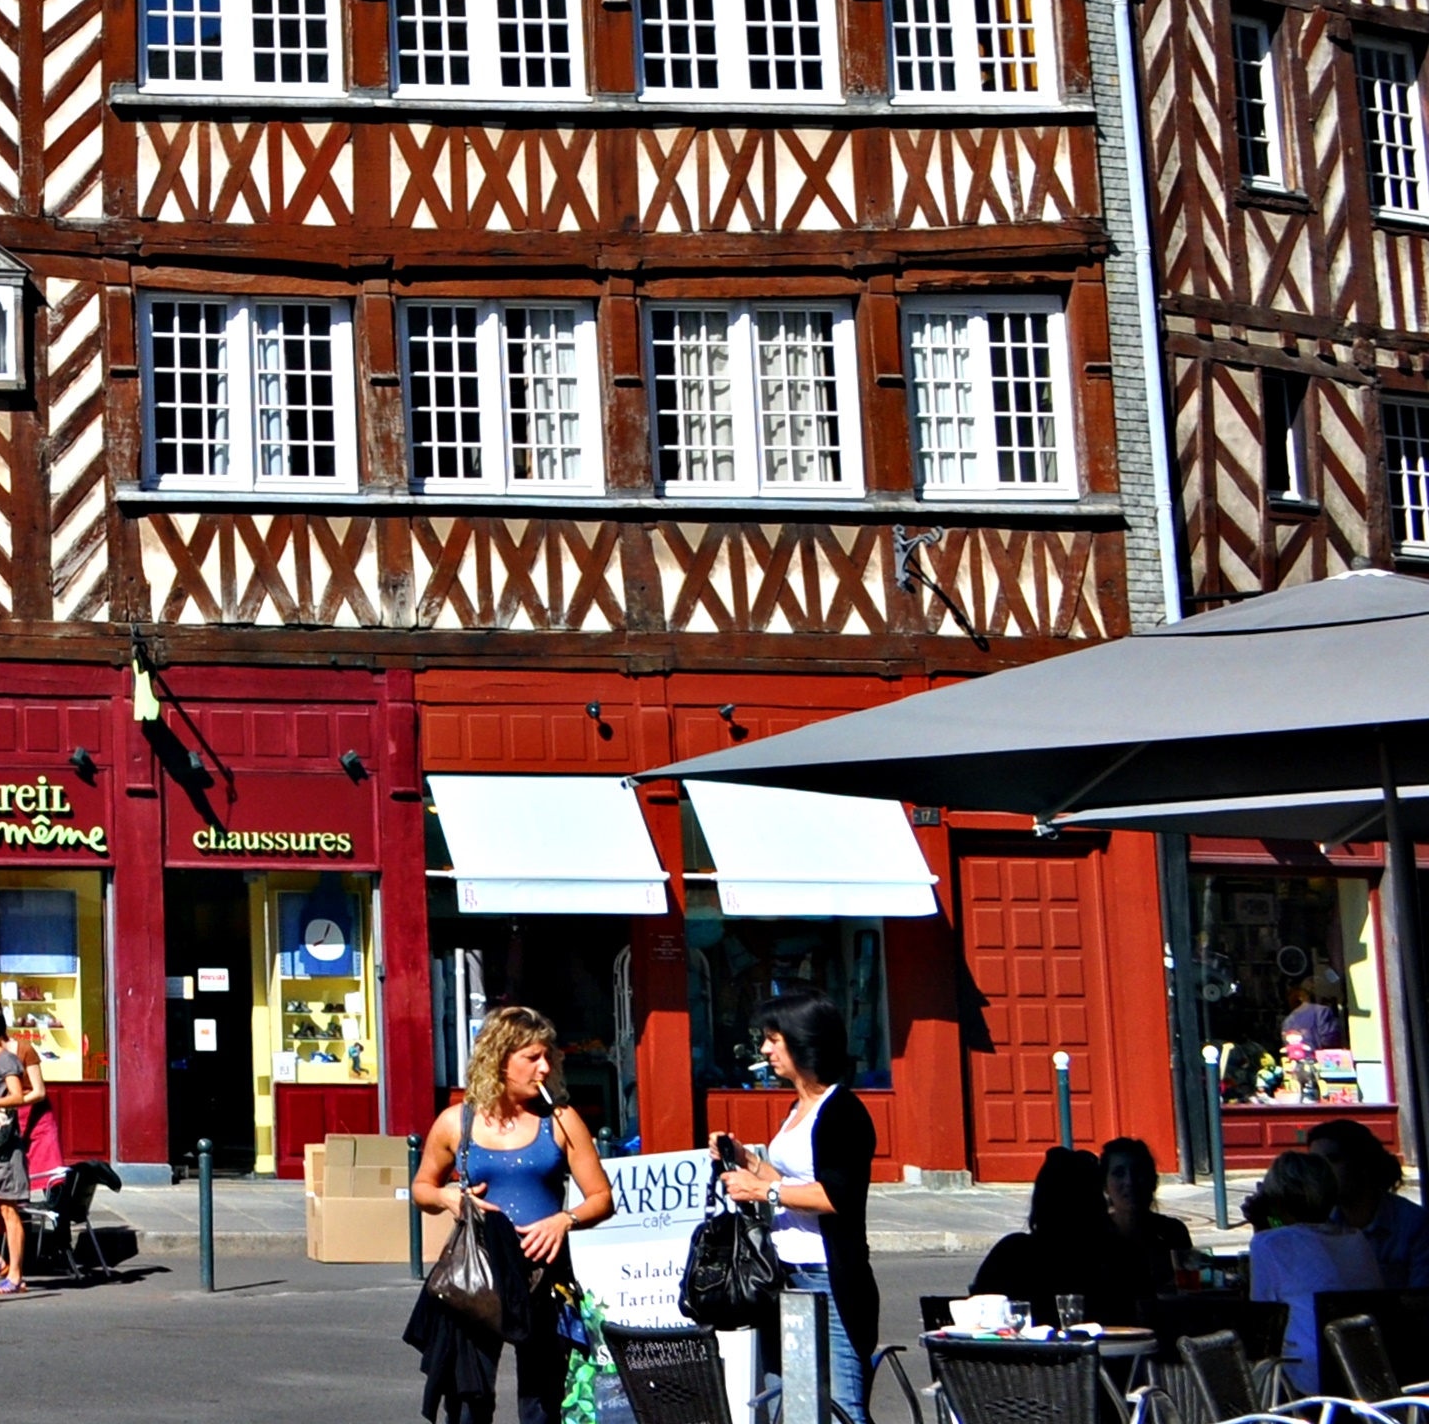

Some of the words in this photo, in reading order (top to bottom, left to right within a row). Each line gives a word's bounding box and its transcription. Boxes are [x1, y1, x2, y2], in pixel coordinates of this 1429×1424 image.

[920, 810, 931, 822] 17
[193, 825, 352, 853] chaussures
[642, 1212, 672, 1229] café
